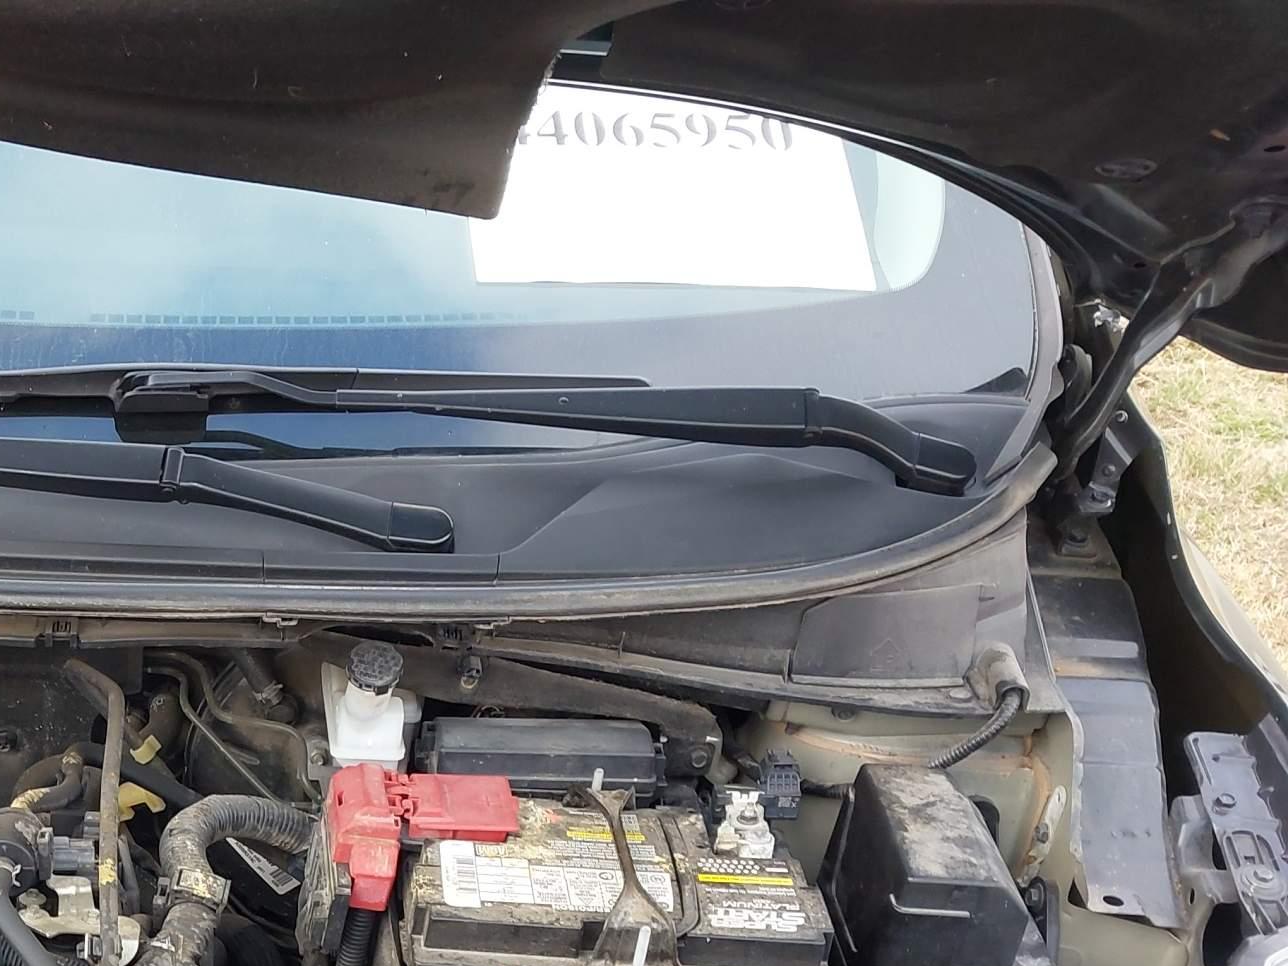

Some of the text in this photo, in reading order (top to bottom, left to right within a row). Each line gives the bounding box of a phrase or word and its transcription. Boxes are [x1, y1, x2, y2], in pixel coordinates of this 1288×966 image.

[722, 900, 800, 911] PLATINUM
[709, 906, 807, 926] START
[710, 917, 798, 932] SUPER
